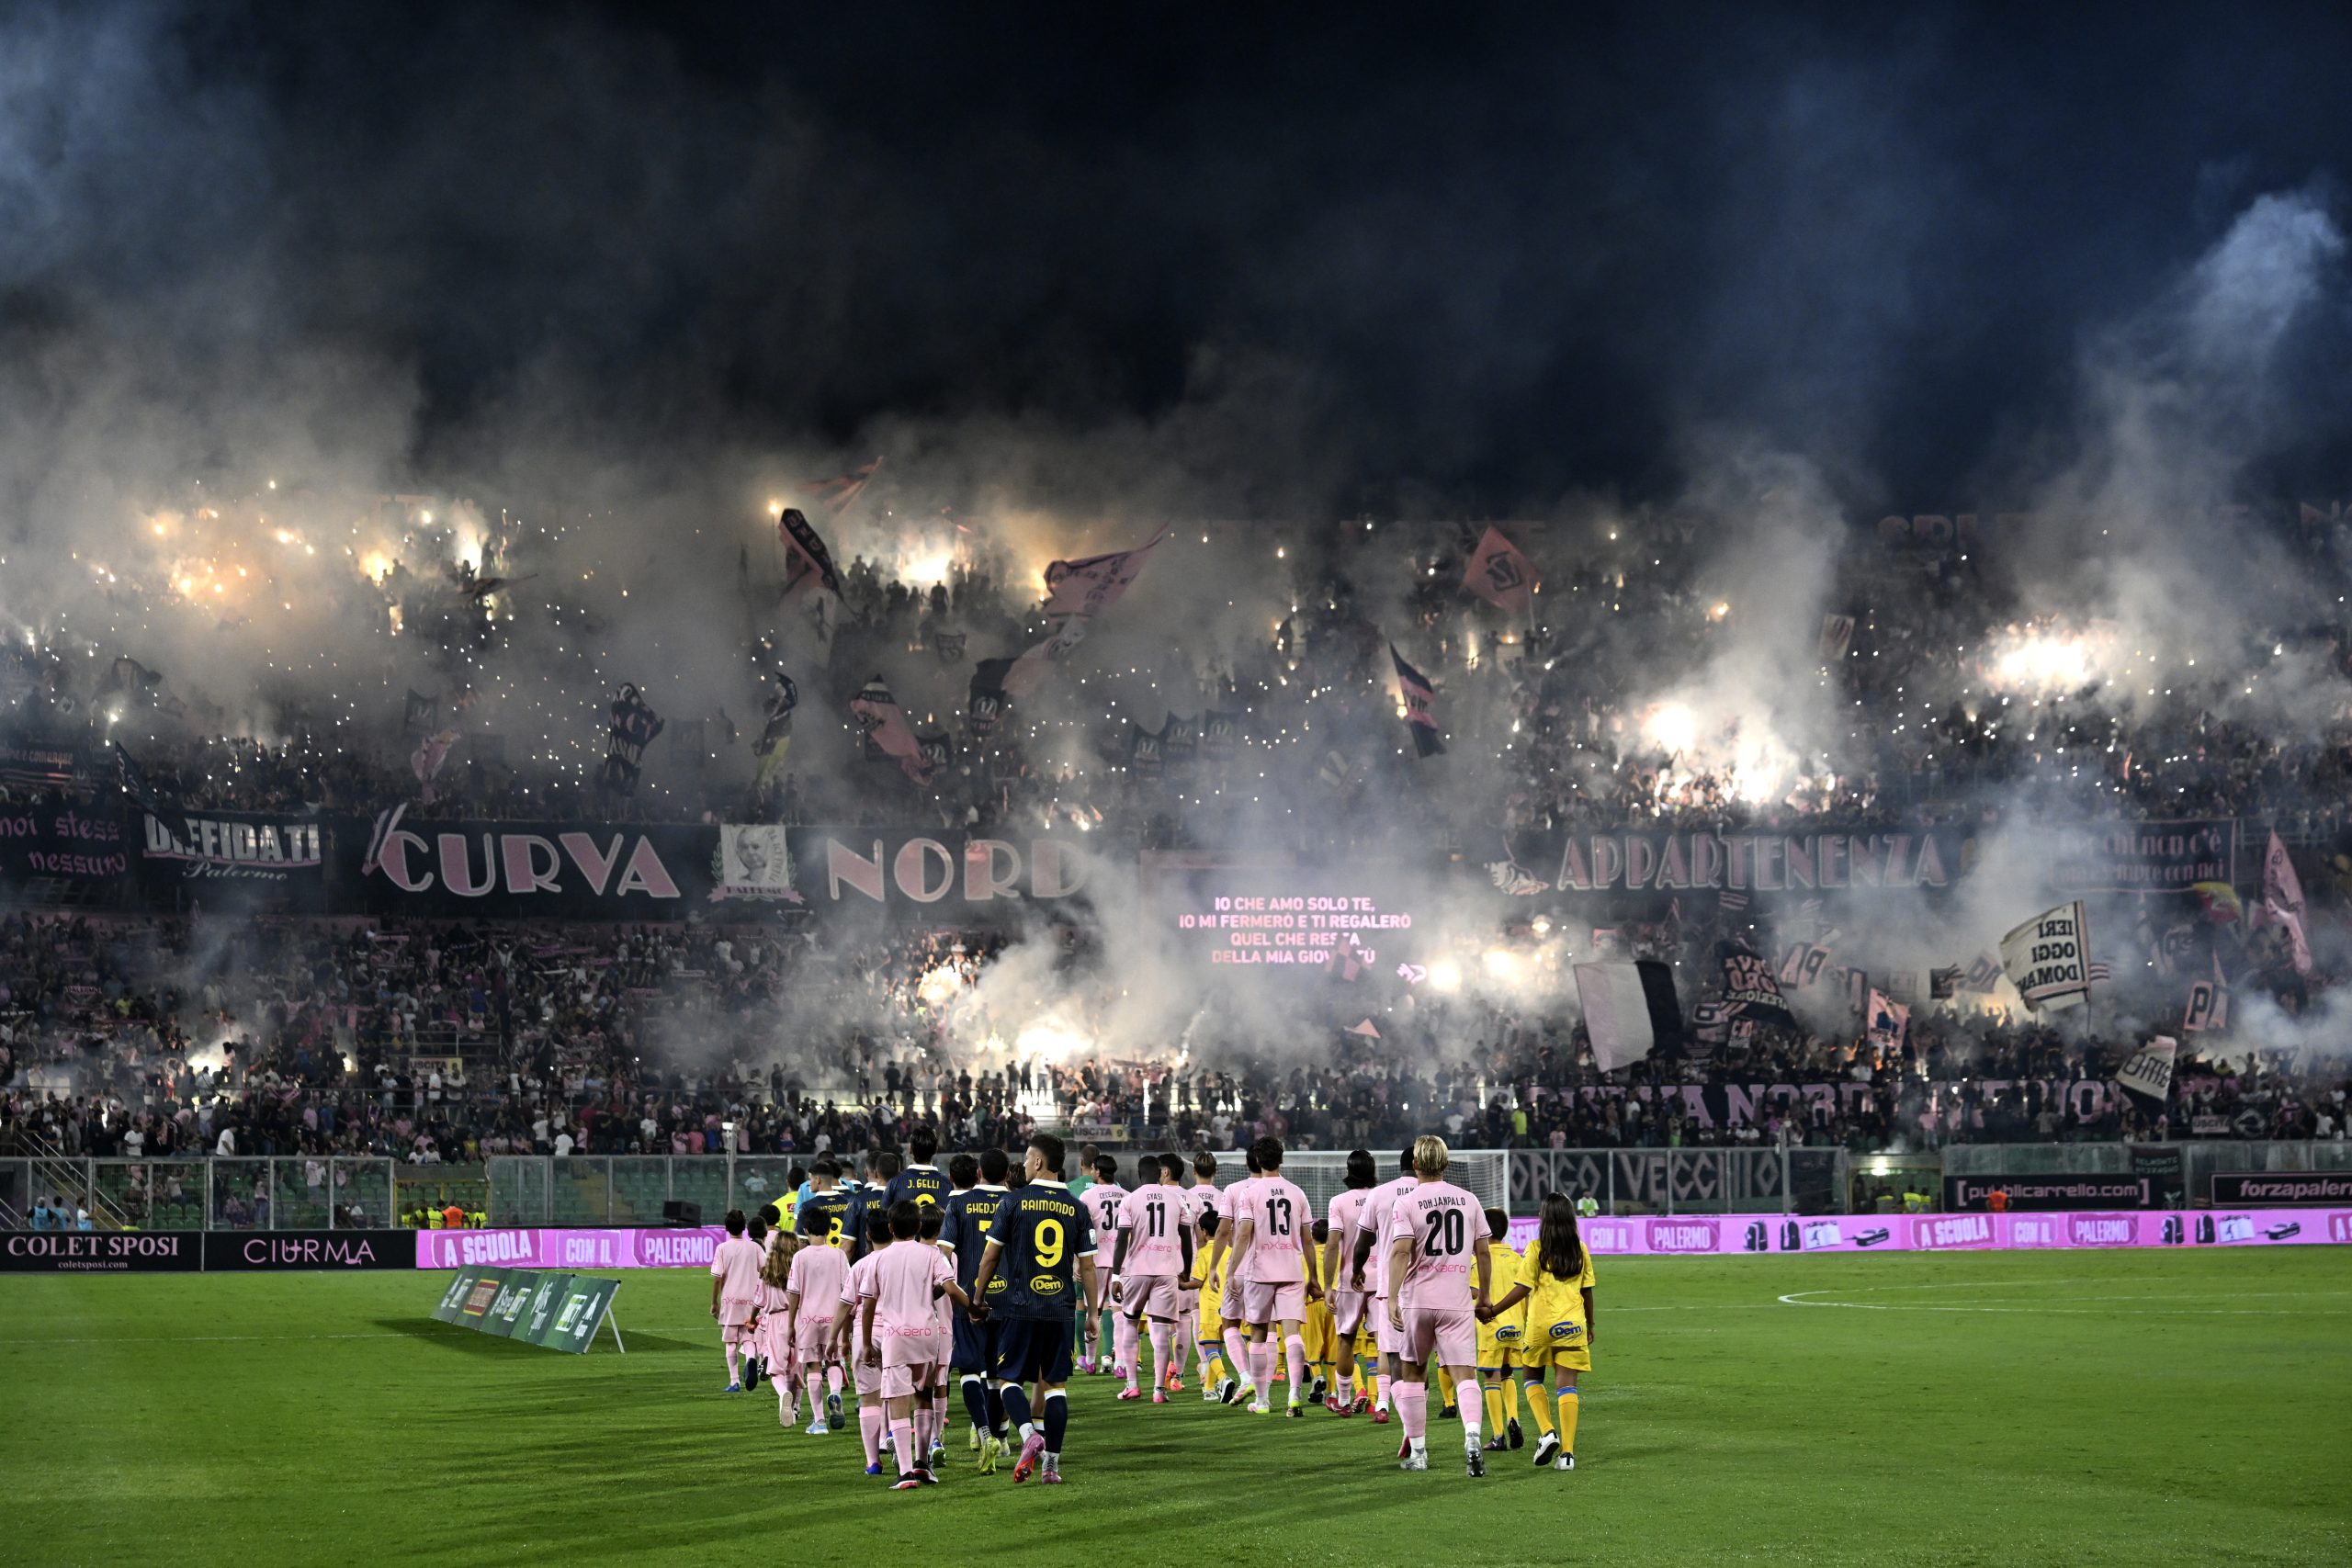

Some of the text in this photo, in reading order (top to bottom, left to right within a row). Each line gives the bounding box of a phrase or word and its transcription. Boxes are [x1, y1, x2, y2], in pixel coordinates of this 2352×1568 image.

[182, 860, 288, 881] Palermo
[378, 829, 682, 897] CURVA
[827, 837, 1091, 903] NORD
[1557, 832, 1949, 891] APPARTENENZA
[1215, 897, 1230, 911] IO
[1234, 897, 1265, 911] CHE
[1269, 897, 1304, 911] AMO
[1307, 897, 1348, 911] SOLO
[1179, 915, 1194, 929] IO
[1199, 915, 1216, 929] MI
[1297, 915, 1307, 929] E
[1312, 915, 1326, 929] TI
[1230, 932, 1361, 946] QUEL CHE RESA
[1212, 950, 1262, 964] DELLA
[1265, 950, 1295, 964] MIA
[1074, 1127, 1113, 1136] USCITA
[917, 1179, 940, 1189] GELLI
[2240, 1179, 2352, 1201] forzapaler
[1021, 1199, 1075, 1217] RAIMONDO
[1418, 1197, 1466, 1211] POHJANPALO
[1146, 1201, 1166, 1237] 11
[1266, 1198, 1291, 1236] 13
[1425, 1208, 1464, 1257] 20
[1590, 1227, 1613, 1249] CON
[1617, 1228, 1628, 1249] IL
[1654, 1226, 1711, 1250] PALERMO
[1921, 1215, 2129, 1247] A SCUOLA CON IL PALERMO
[2335, 1217, 2346, 1241] A
[7, 1235, 179, 1258] COLET SPOSI
[243, 1238, 377, 1266] CIURMA
[444, 1230, 715, 1266] A SCUOLA CON IL PALERMO
[1035, 1218, 1064, 1268] 9
[57, 1260, 129, 1270] coletsposi.com
[1035, 1278, 1061, 1290] Dem
[1499, 1329, 1521, 1339] Dem
[1554, 1325, 1582, 1337] Dem
